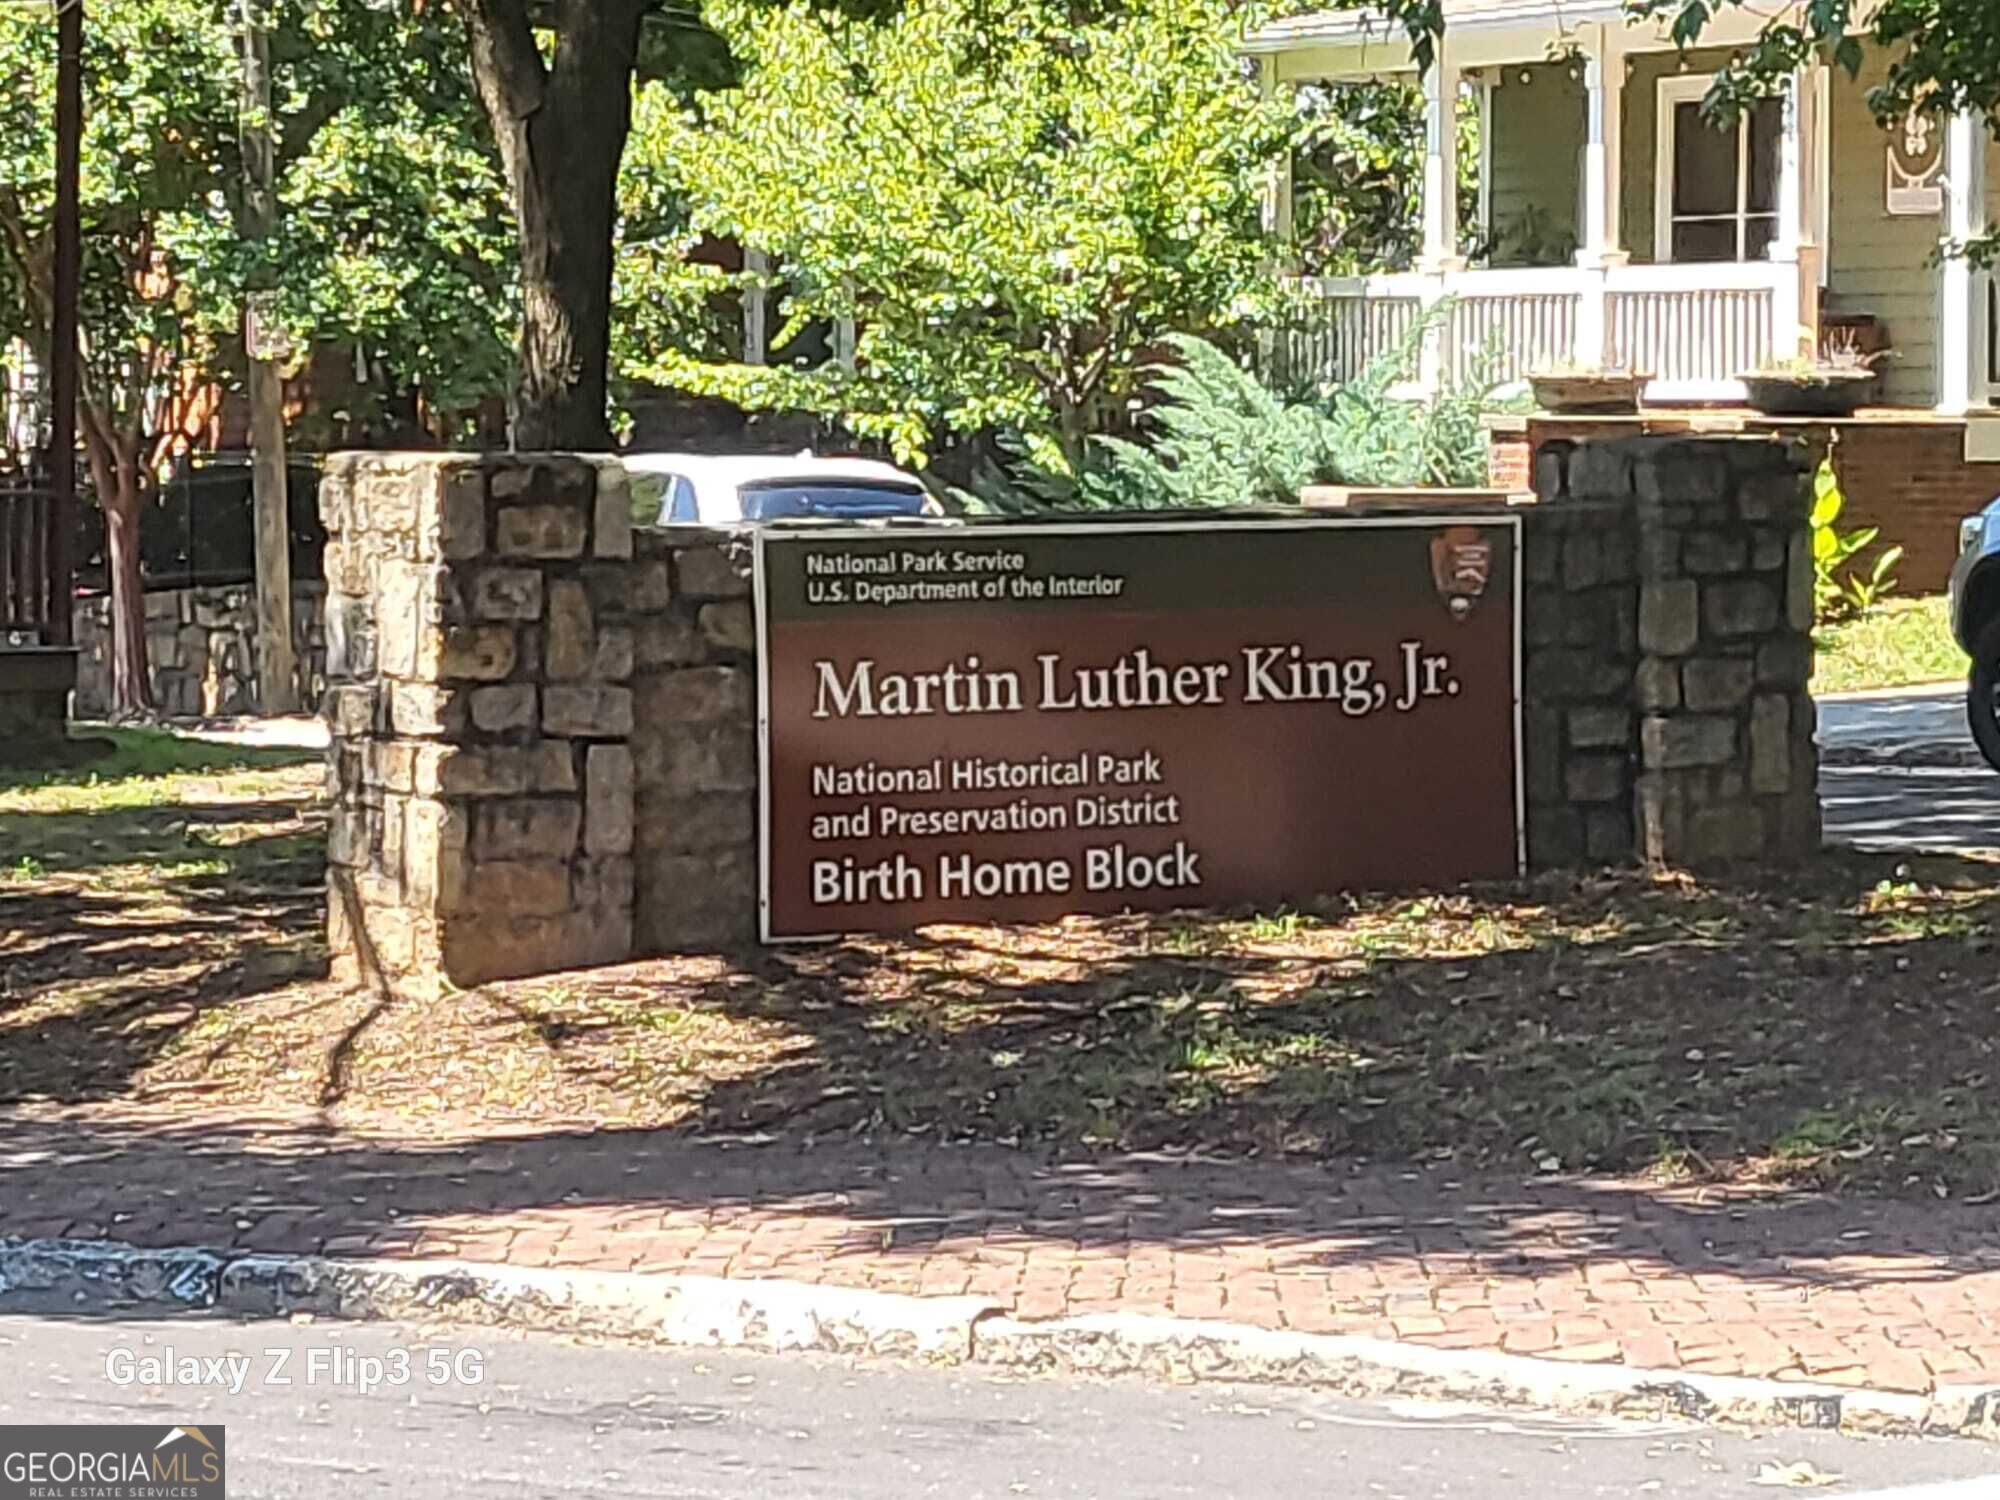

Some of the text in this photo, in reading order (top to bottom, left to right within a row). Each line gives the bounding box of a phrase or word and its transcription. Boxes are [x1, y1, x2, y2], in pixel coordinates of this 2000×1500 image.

[806, 549, 1025, 574] National Park Service
[808, 574, 1124, 605] U.S. Department of the Interior
[812, 642, 1460, 717] Martin Luther King, Jr.
[812, 750, 1162, 796] National Historical Park
[811, 793, 1180, 838] and Preservation District
[812, 842, 1201, 903] Birth Home Block
